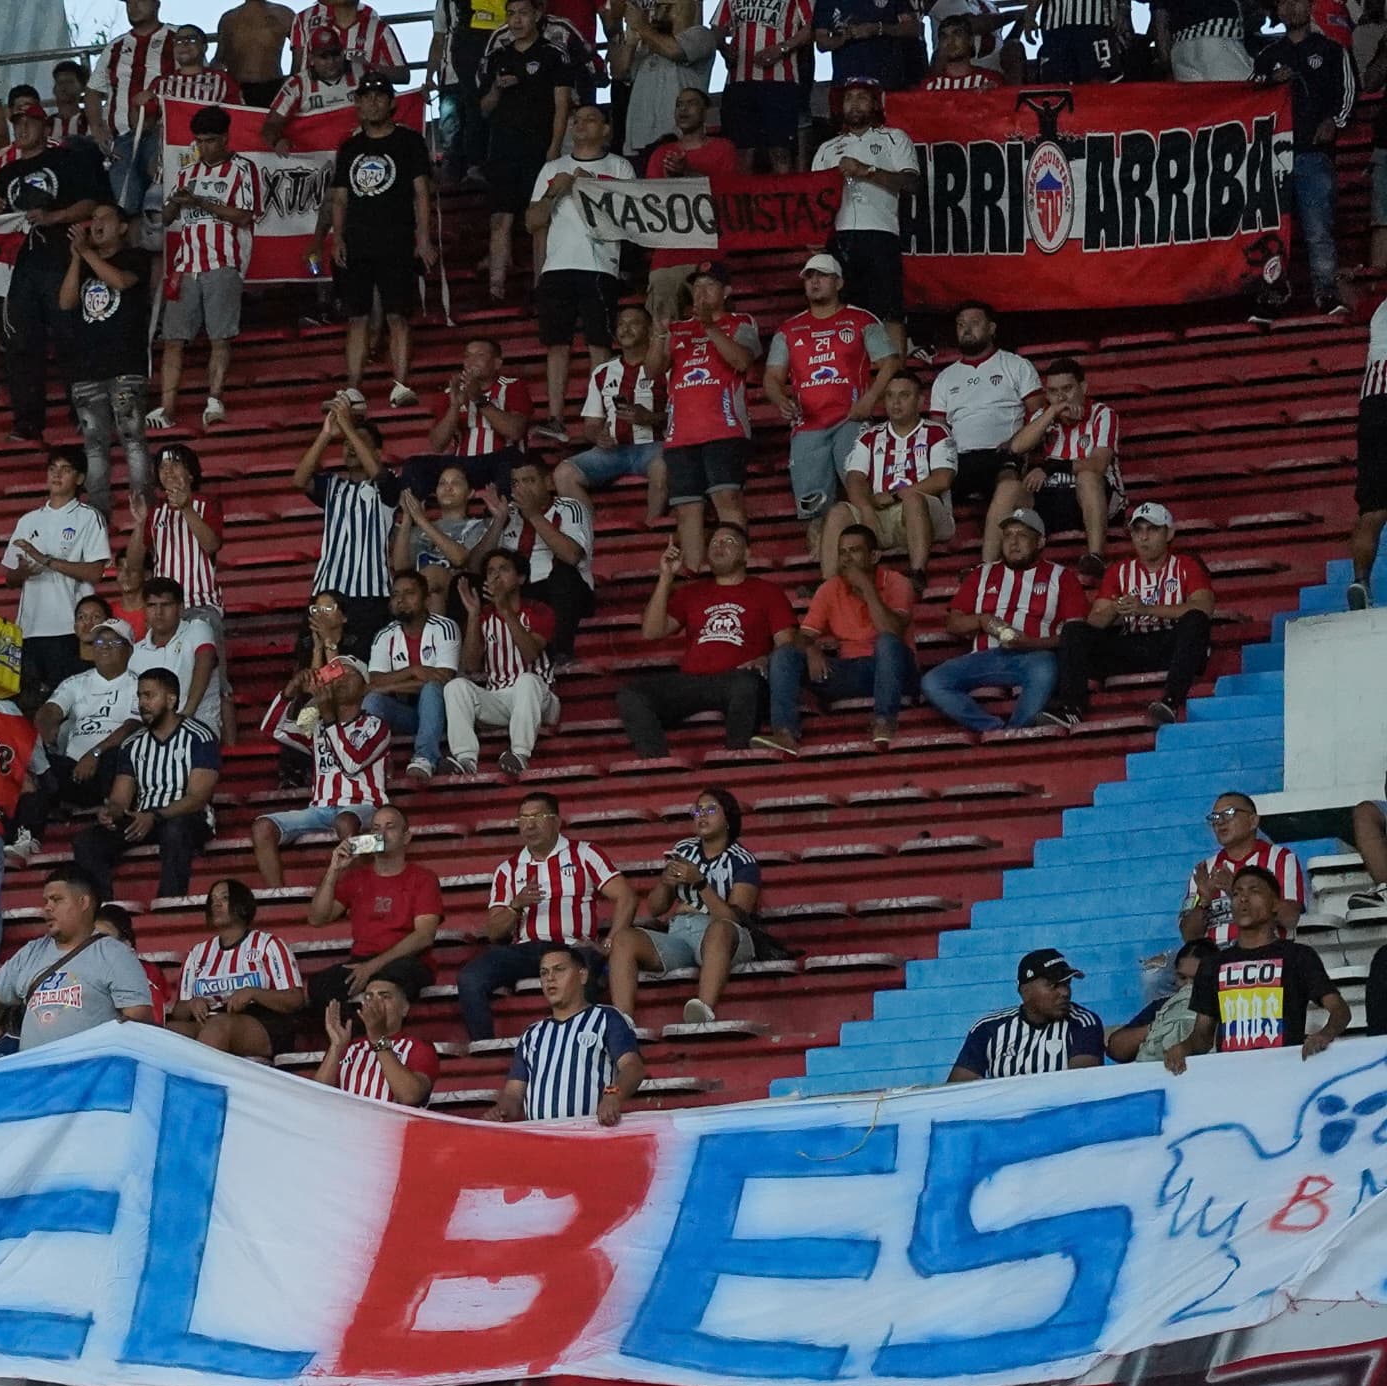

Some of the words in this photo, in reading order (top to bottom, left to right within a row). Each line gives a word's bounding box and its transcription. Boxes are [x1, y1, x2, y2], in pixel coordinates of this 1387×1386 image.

[1082, 113, 1282, 253] ARRIBA
[577, 187, 838, 234] MASOQUISTAS
[814, 337, 830, 351] 29
[808, 352, 836, 366] AGUILA
[799, 377, 850, 388] OLIMPICA
[201, 975, 260, 997] AGUILA
[1225, 963, 1276, 987] LCO
